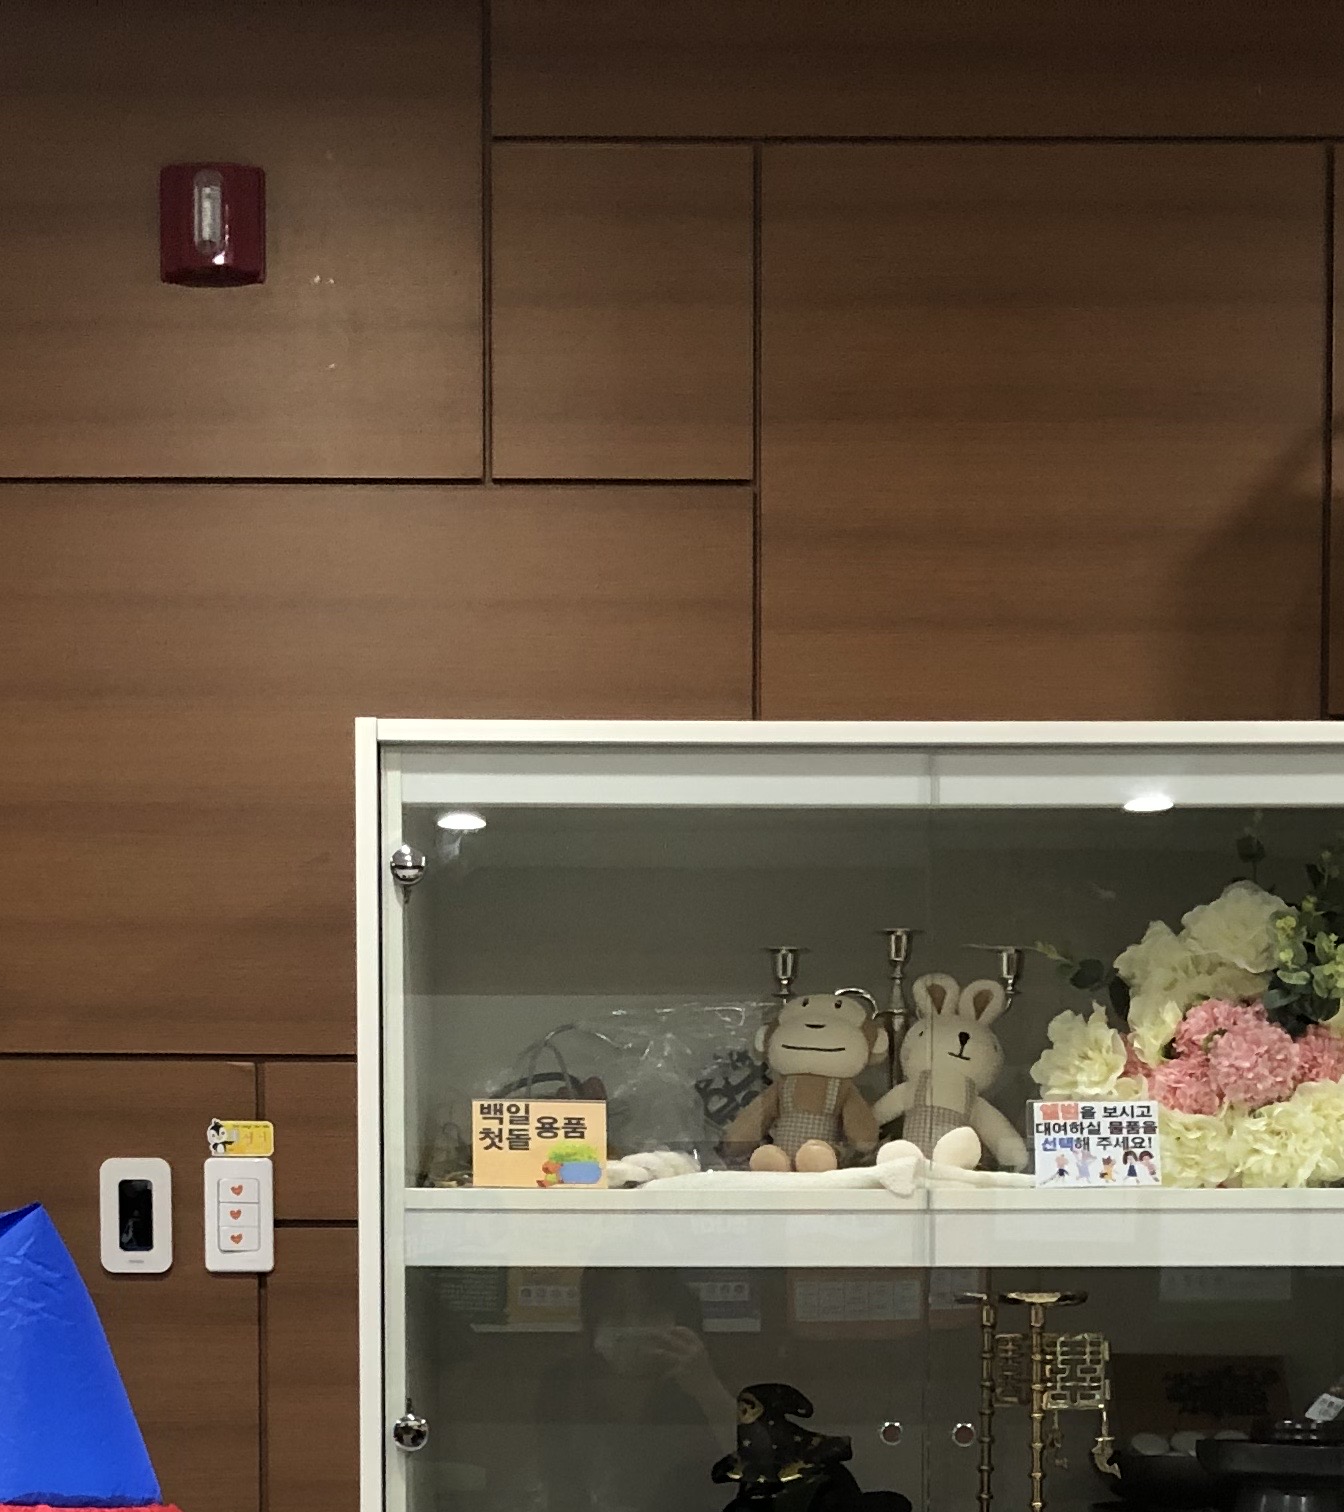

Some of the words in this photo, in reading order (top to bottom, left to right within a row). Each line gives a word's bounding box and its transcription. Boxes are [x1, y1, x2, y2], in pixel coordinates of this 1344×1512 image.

[480, 1103, 530, 1125] 백일
[1102, 1105, 1152, 1118] 보시고
[535, 1116, 587, 1139] 용품
[1036, 1121, 1101, 1136] 대여하실
[479, 1127, 531, 1151] 첫돌
[1042, 1137, 1090, 1151] 선택해
[1096, 1137, 1152, 1150] 주세요!
